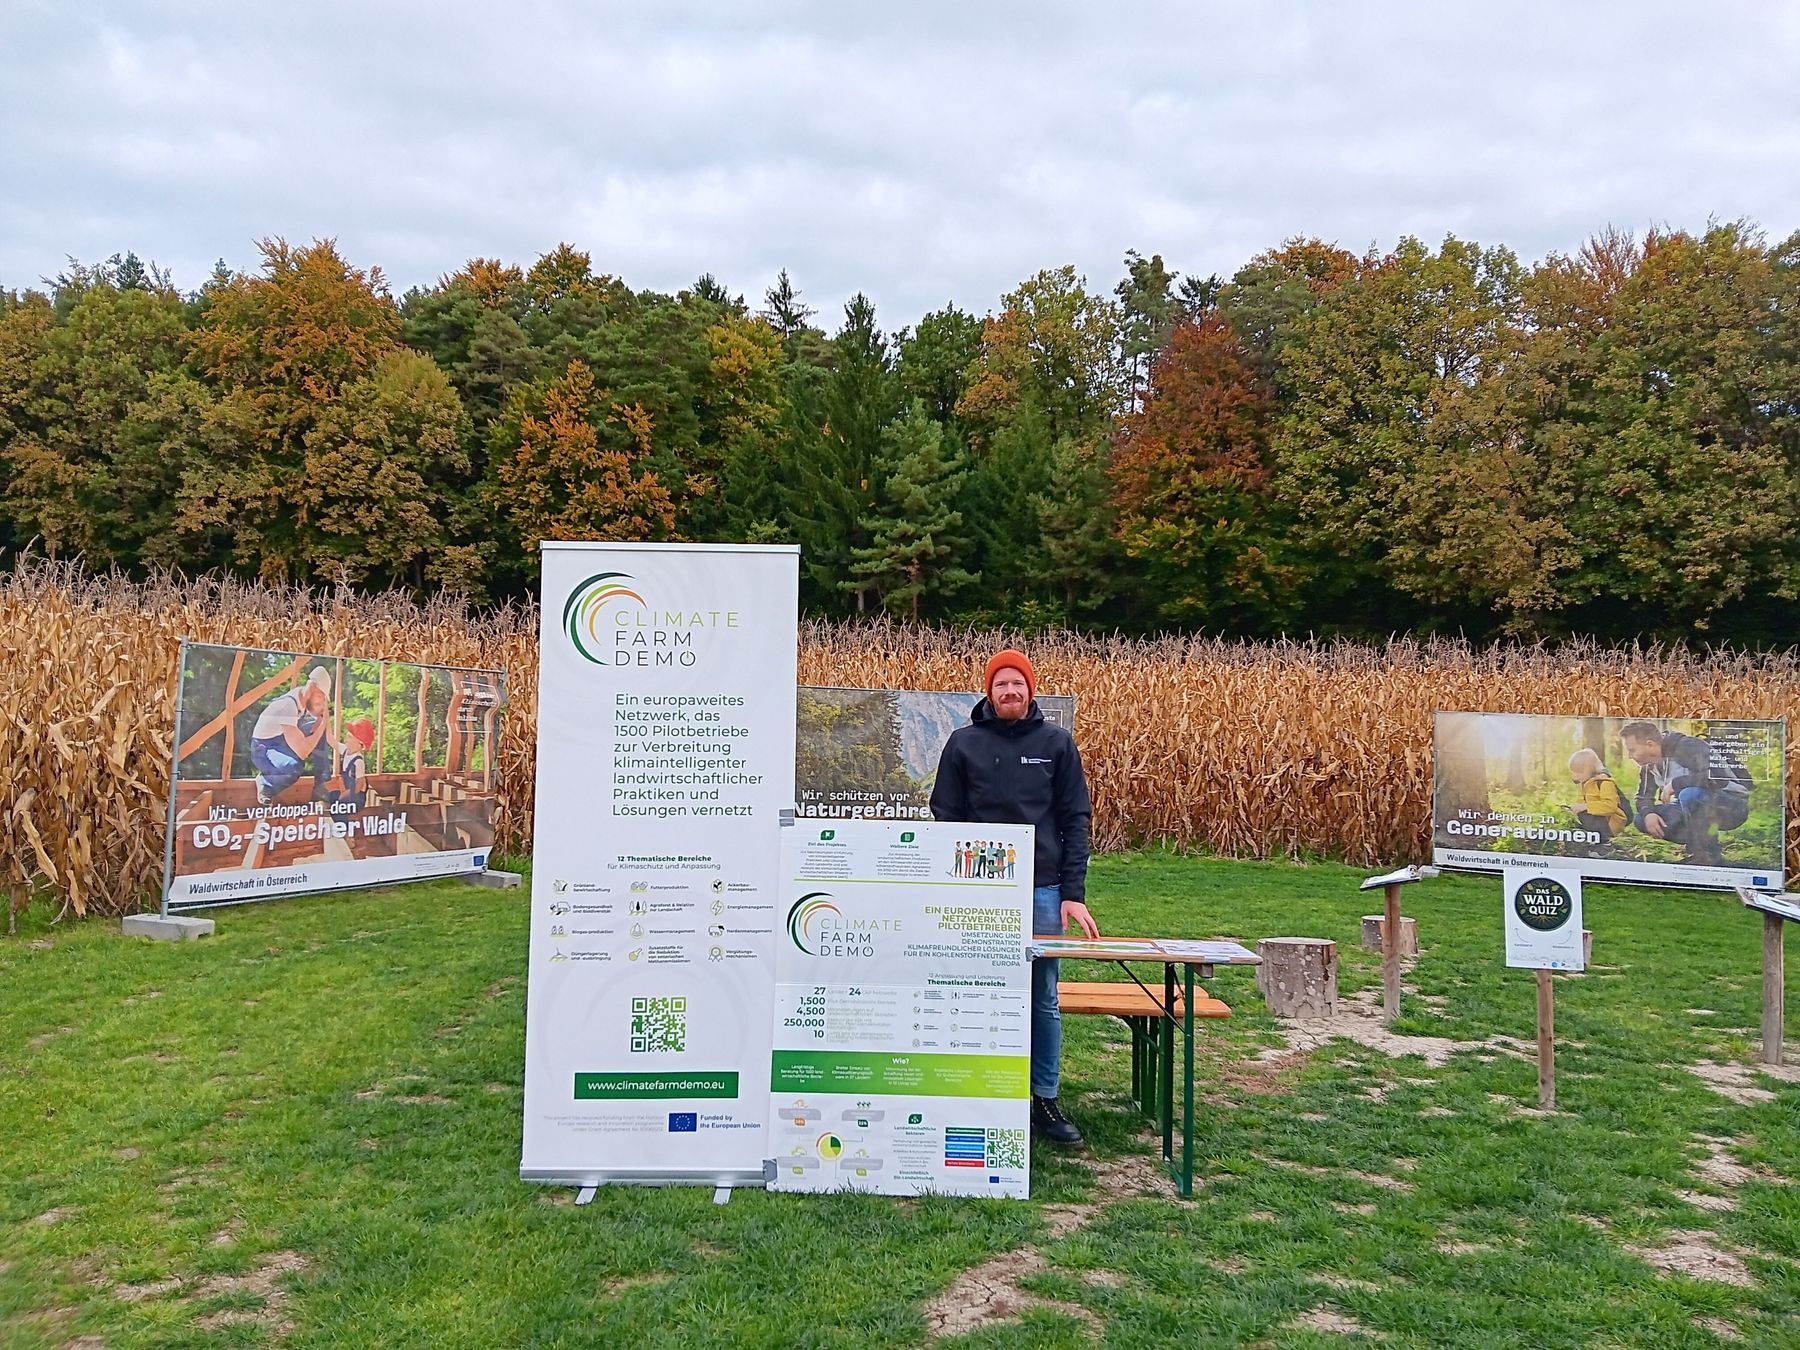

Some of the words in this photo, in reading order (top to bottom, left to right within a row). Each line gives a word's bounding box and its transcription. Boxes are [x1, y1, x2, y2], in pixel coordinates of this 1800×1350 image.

[615, 611, 739, 627] CLIMATE
[615, 631, 691, 646] FARM
[615, 650, 696, 666] DEMO
[616, 693, 639, 705] Ein
[643, 694, 744, 708] europaweites
[615, 710, 690, 723] Netzwerk,
[694, 710, 721, 721] das
[614, 725, 648, 737] 1500
[652, 725, 749, 737] Pilotbetriebe
[613, 743, 638, 753] zur
[641, 741, 732, 756] Verbreitung
[614, 756, 747, 771] klimaintelligenter
[613, 772, 763, 785] landwirtschaftlicher
[613, 788, 685, 800] Praktiken
[689, 788, 719, 800] und
[802, 789, 824, 800] Wir
[829, 790, 884, 801] schützen
[889, 792, 910, 801] vor
[208, 805, 238, 821] Wir
[247, 801, 324, 820] verdoppeln
[330, 800, 357, 815] den
[612, 804, 687, 819] Lösungen
[691, 805, 753, 816] vernetzt
[1458, 808, 1482, 819] Wir
[1487, 810, 1532, 823] denken
[1539, 813, 1555, 825] in
[363, 812, 408, 837] Wald
[1446, 820, 1601, 844] Generationen
[607, 862, 618, 870] für
[619, 862, 664, 870] Klimaschutz
[665, 862, 680, 870] und
[681, 862, 721, 871] Anpassung
[1446, 853, 1501, 865] Waldwirtschaft
[1510, 858, 1549, 868] Österreich
[189, 878, 255, 895] Waldwirtschaft
[256, 877, 265, 887] in
[266, 873, 308, 887] Österreich
[1523, 894, 1564, 906] WALD
[925, 906, 941, 914] EIN
[944, 906, 1022, 917] EUROPAWEITES
[1528, 905, 1558, 916] QUIZ
[820, 918, 903, 932] CLIMATE
[942, 915, 997, 923] NETZWERK
[999, 916, 1021, 925] VON
[938, 922, 1021, 932] PILOTBETRIEBEN
[820, 932, 872, 944] FARM
[961, 931, 1004, 939] UMSETZUNG
[1005, 932, 1021, 940] UND
[907, 944, 982, 952] KLIMAFREUNDLICHER
[961, 938, 1021, 946] DEMONSTRATION
[820, 945, 875, 958] DEMO
[903, 950, 918, 958] FÜR
[931, 951, 1021, 960] KOHLENSTOFFNEUTRALES
[813, 986, 826, 995] 27
[848, 987, 862, 996] 24
[799, 996, 826, 1006] 1,500
[796, 1006, 826, 1016] 4,500
[783, 1018, 825, 1028] 250,000
[813, 1029, 825, 1038] 10
[892, 1057, 910, 1065] Wie?
[587, 1080, 725, 1091] www.climatefarmdemo.eu
[724, 1114, 733, 1123] by
[711, 1122, 742, 1130] European
